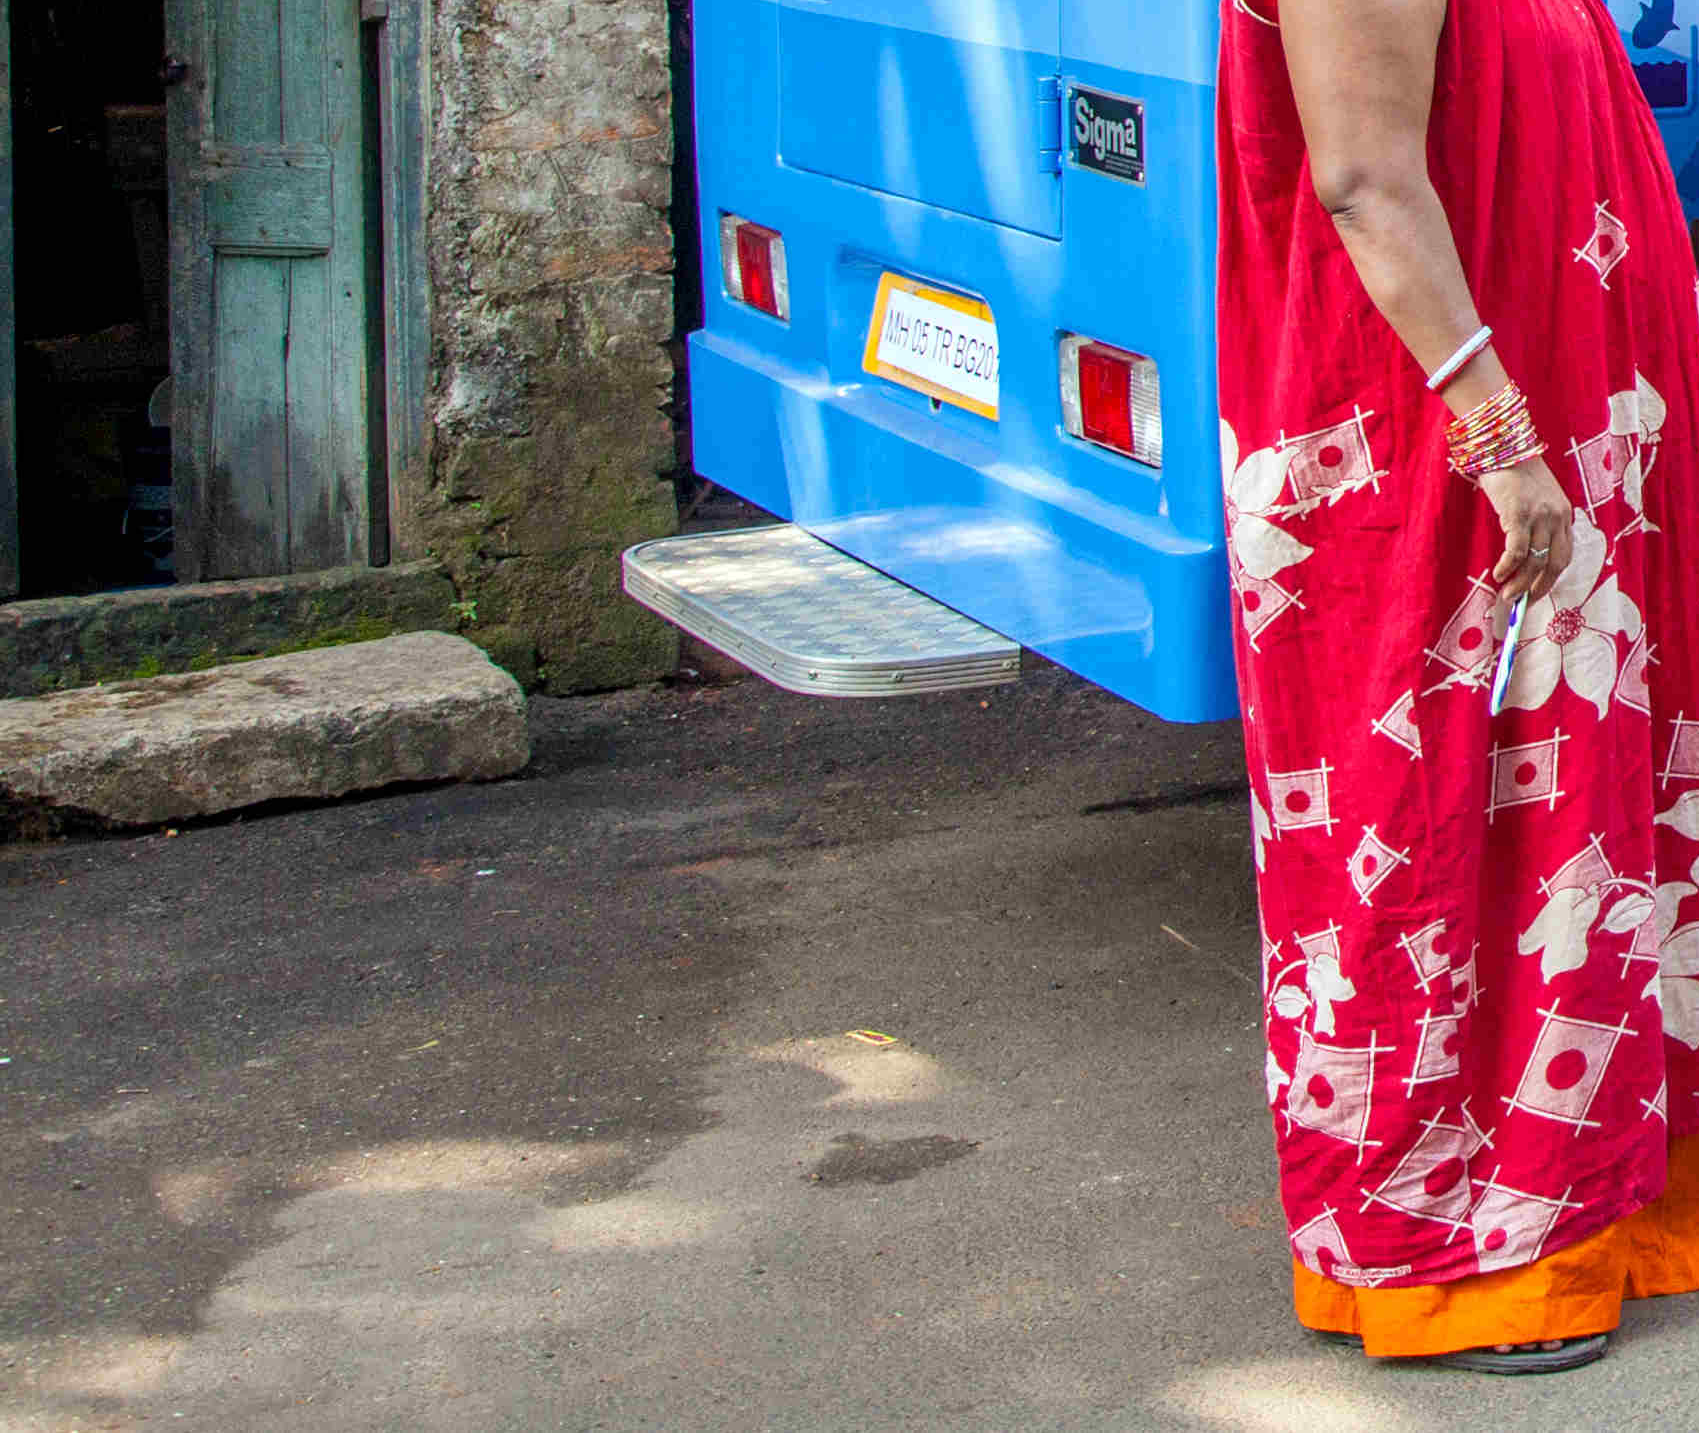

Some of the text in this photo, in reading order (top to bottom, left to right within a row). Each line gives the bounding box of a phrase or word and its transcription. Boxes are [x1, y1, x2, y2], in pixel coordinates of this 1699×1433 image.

[1075, 96, 1136, 160] Sigma
[885, 309, 910, 349] MH
[911, 318, 930, 356] 05
[932, 325, 954, 367] TR
